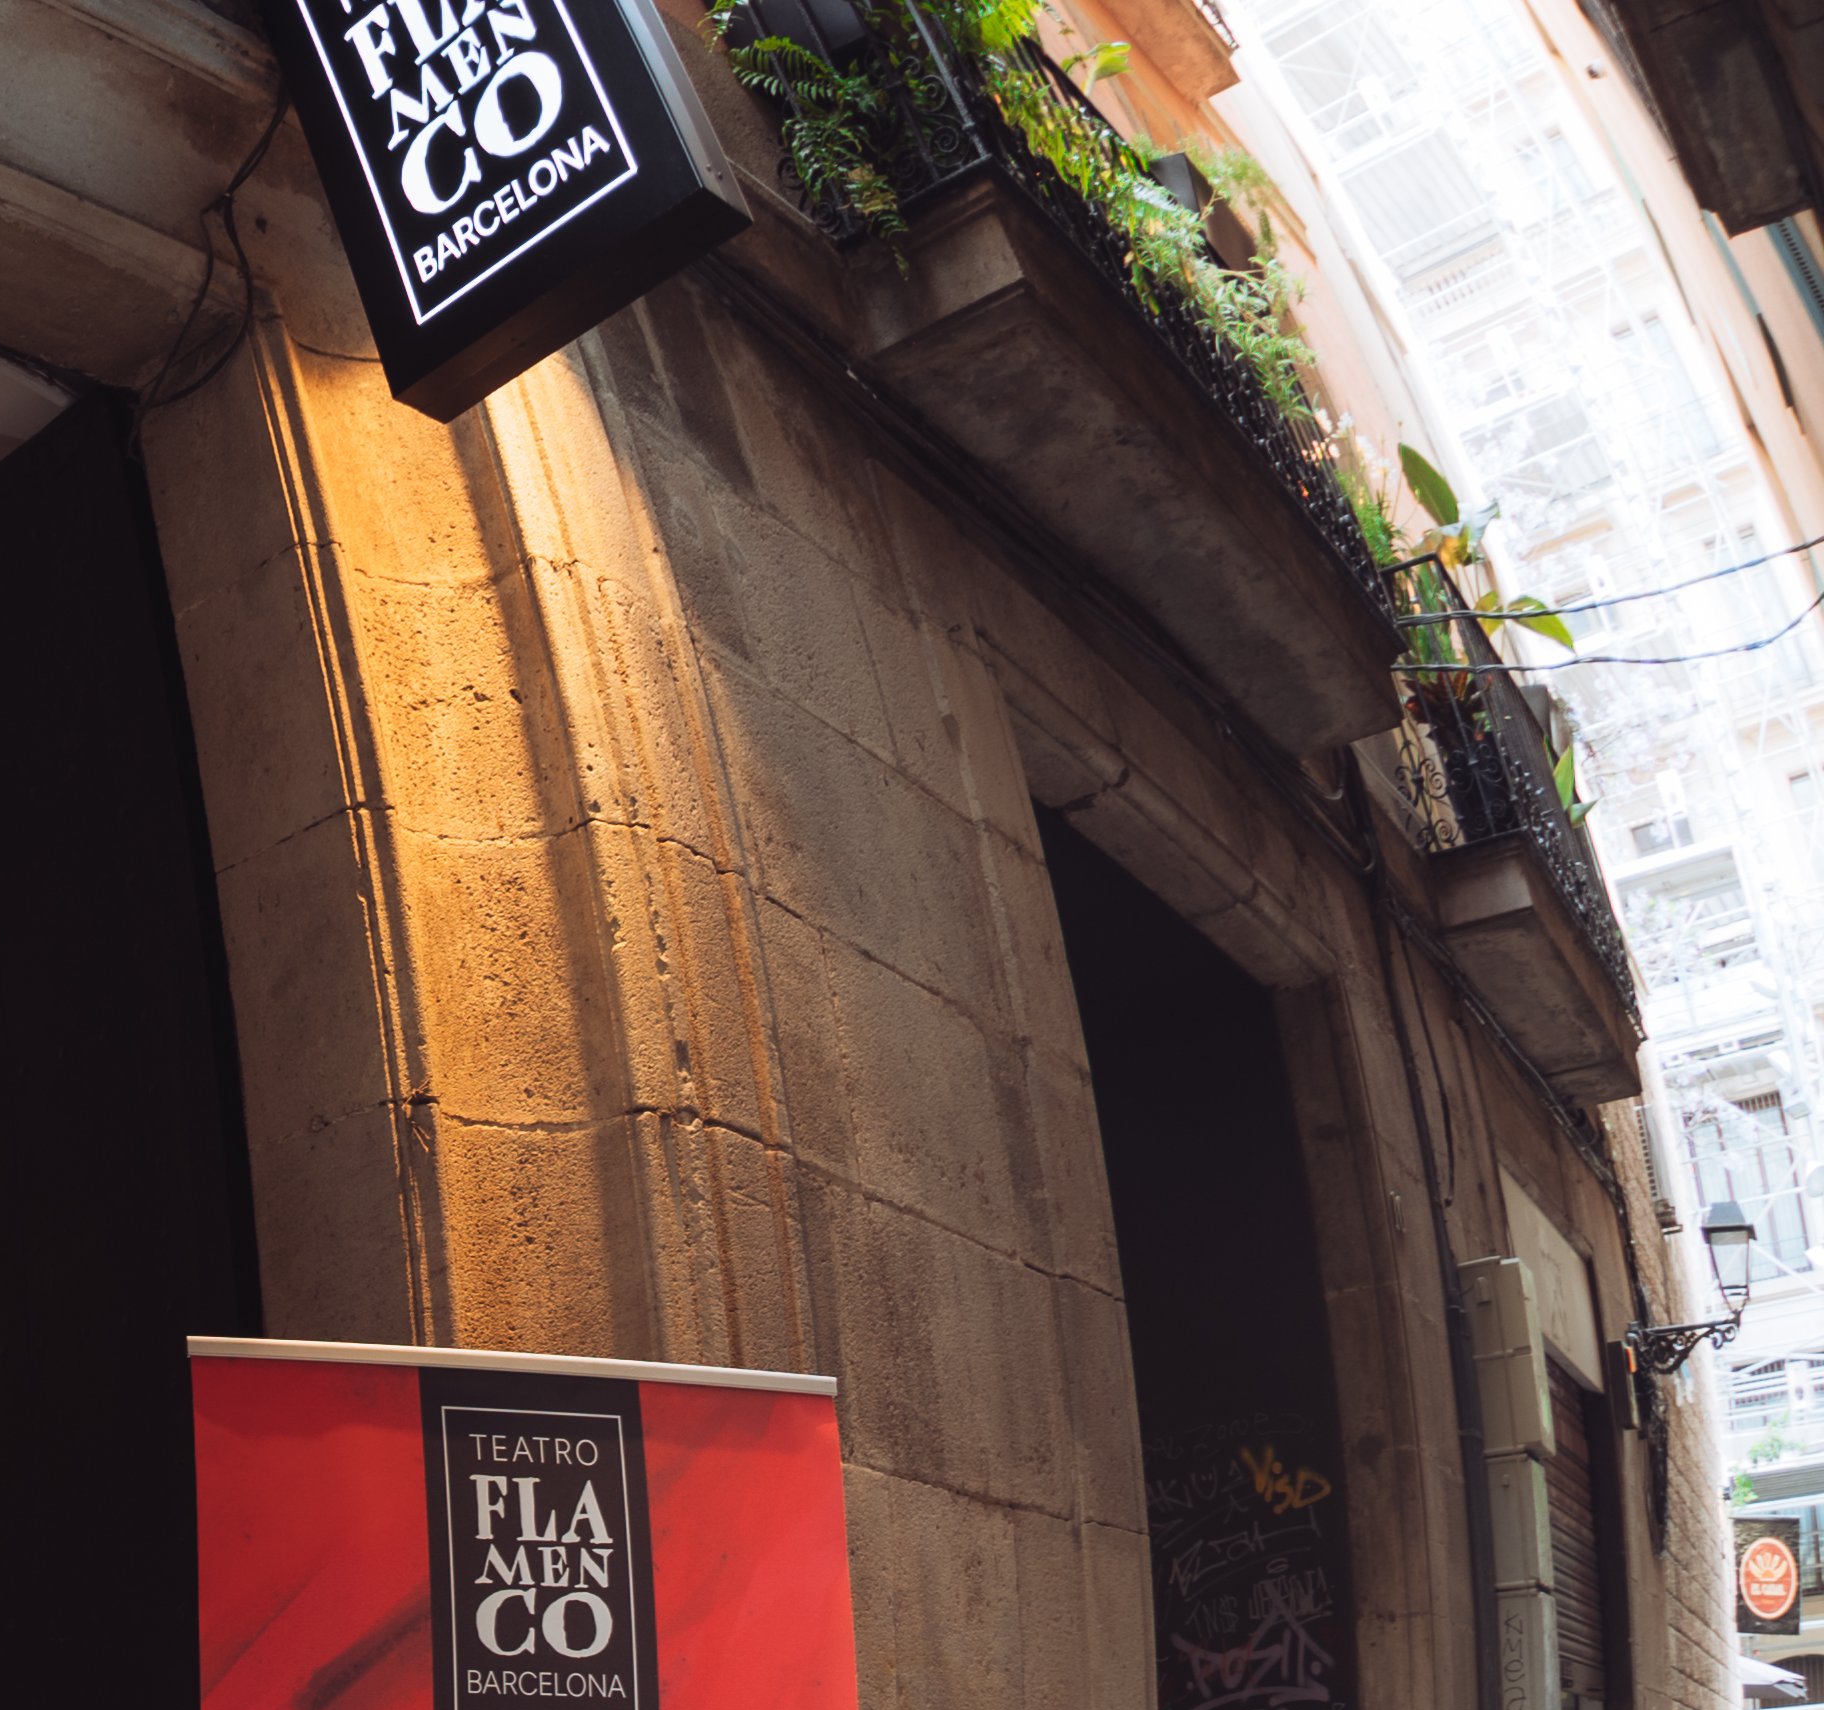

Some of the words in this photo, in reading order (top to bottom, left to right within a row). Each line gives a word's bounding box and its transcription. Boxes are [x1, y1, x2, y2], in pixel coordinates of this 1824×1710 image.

[343, 0, 514, 100] FL
[402, 51, 563, 215] CO
[413, 125, 610, 284] BARCELONA
[468, 1433, 600, 1467] TEATRO
[469, 1474, 614, 1544] FLA
[474, 1544, 614, 1588] MEN
[475, 1587, 613, 1659] CO
[467, 1670, 626, 1699] BARCELONA
